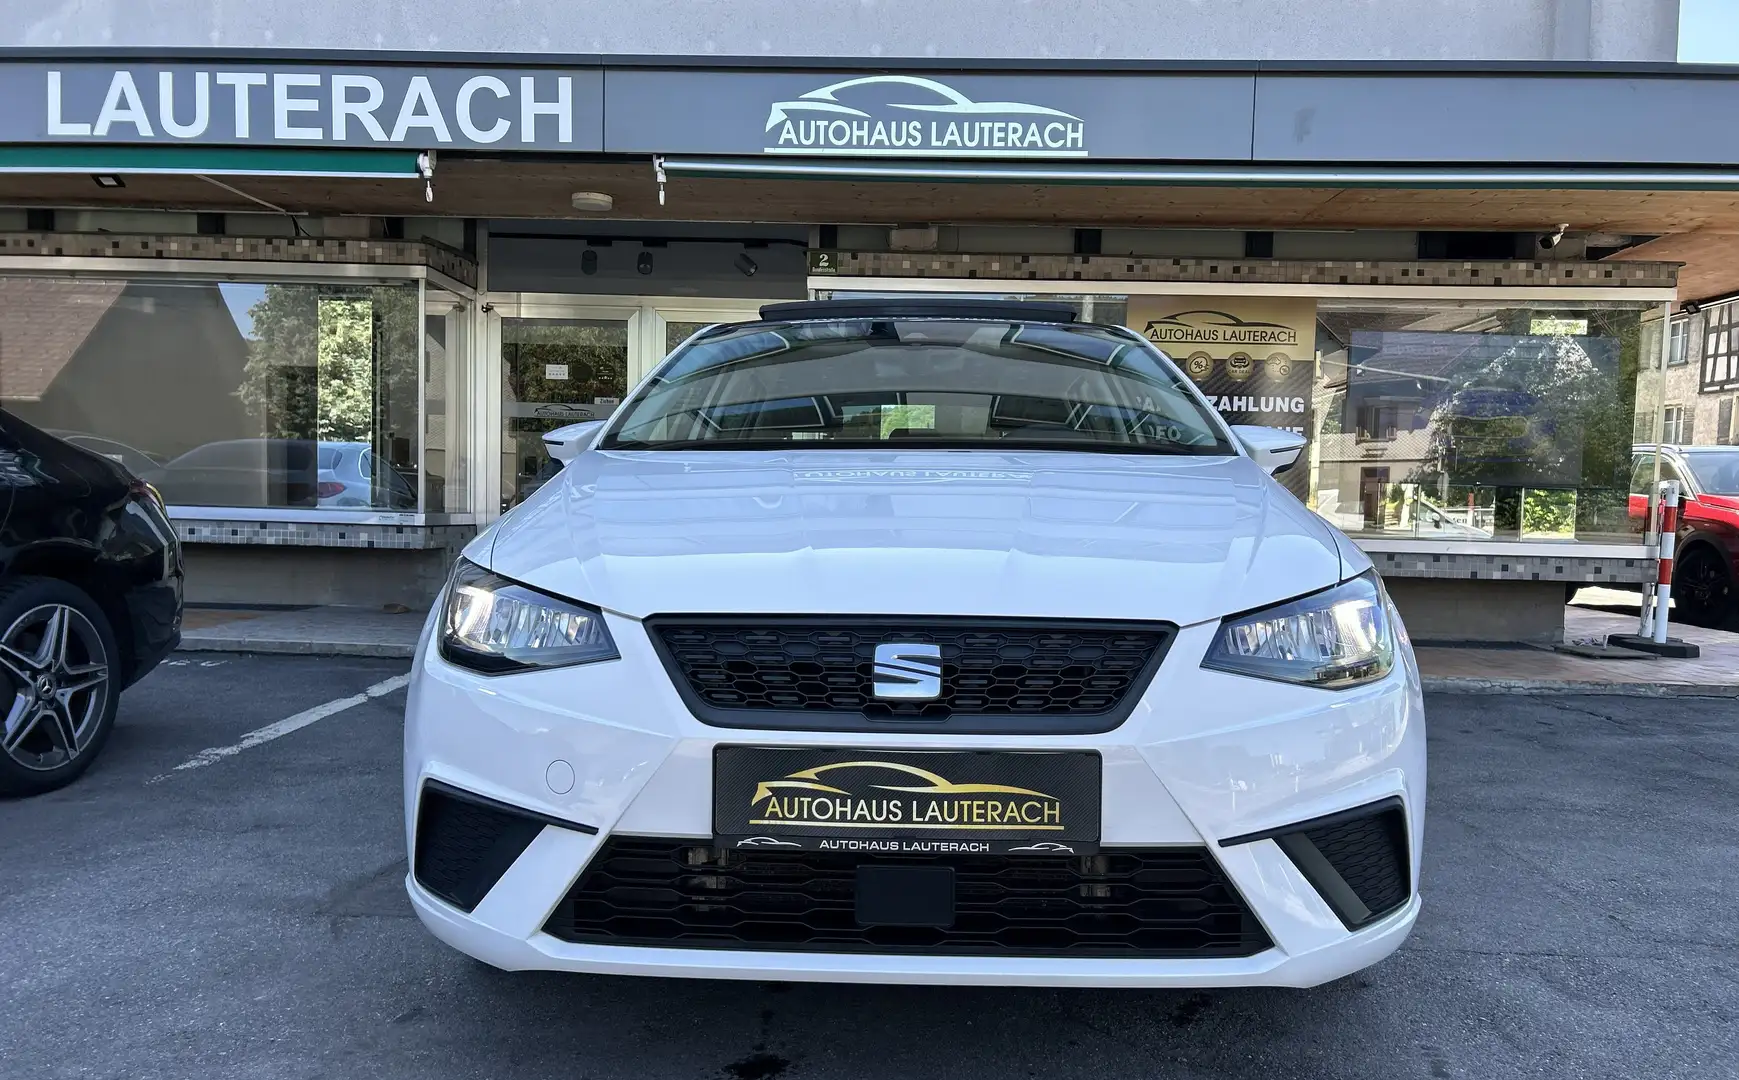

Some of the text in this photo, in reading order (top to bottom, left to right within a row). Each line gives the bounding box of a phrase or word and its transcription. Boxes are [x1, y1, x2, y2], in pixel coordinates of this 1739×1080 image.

[46, 70, 573, 144] LAUTERACH
[778, 120, 1085, 149] AUTOHAUS LAUTERACH
[819, 253, 829, 267] 2
[1150, 328, 1297, 343] AUTOHAUS LAUTERACH
[764, 796, 1062, 824] AUTOHAUS LAUTERACH
[819, 839, 990, 852] AUTOHAUS LAUTERACH
